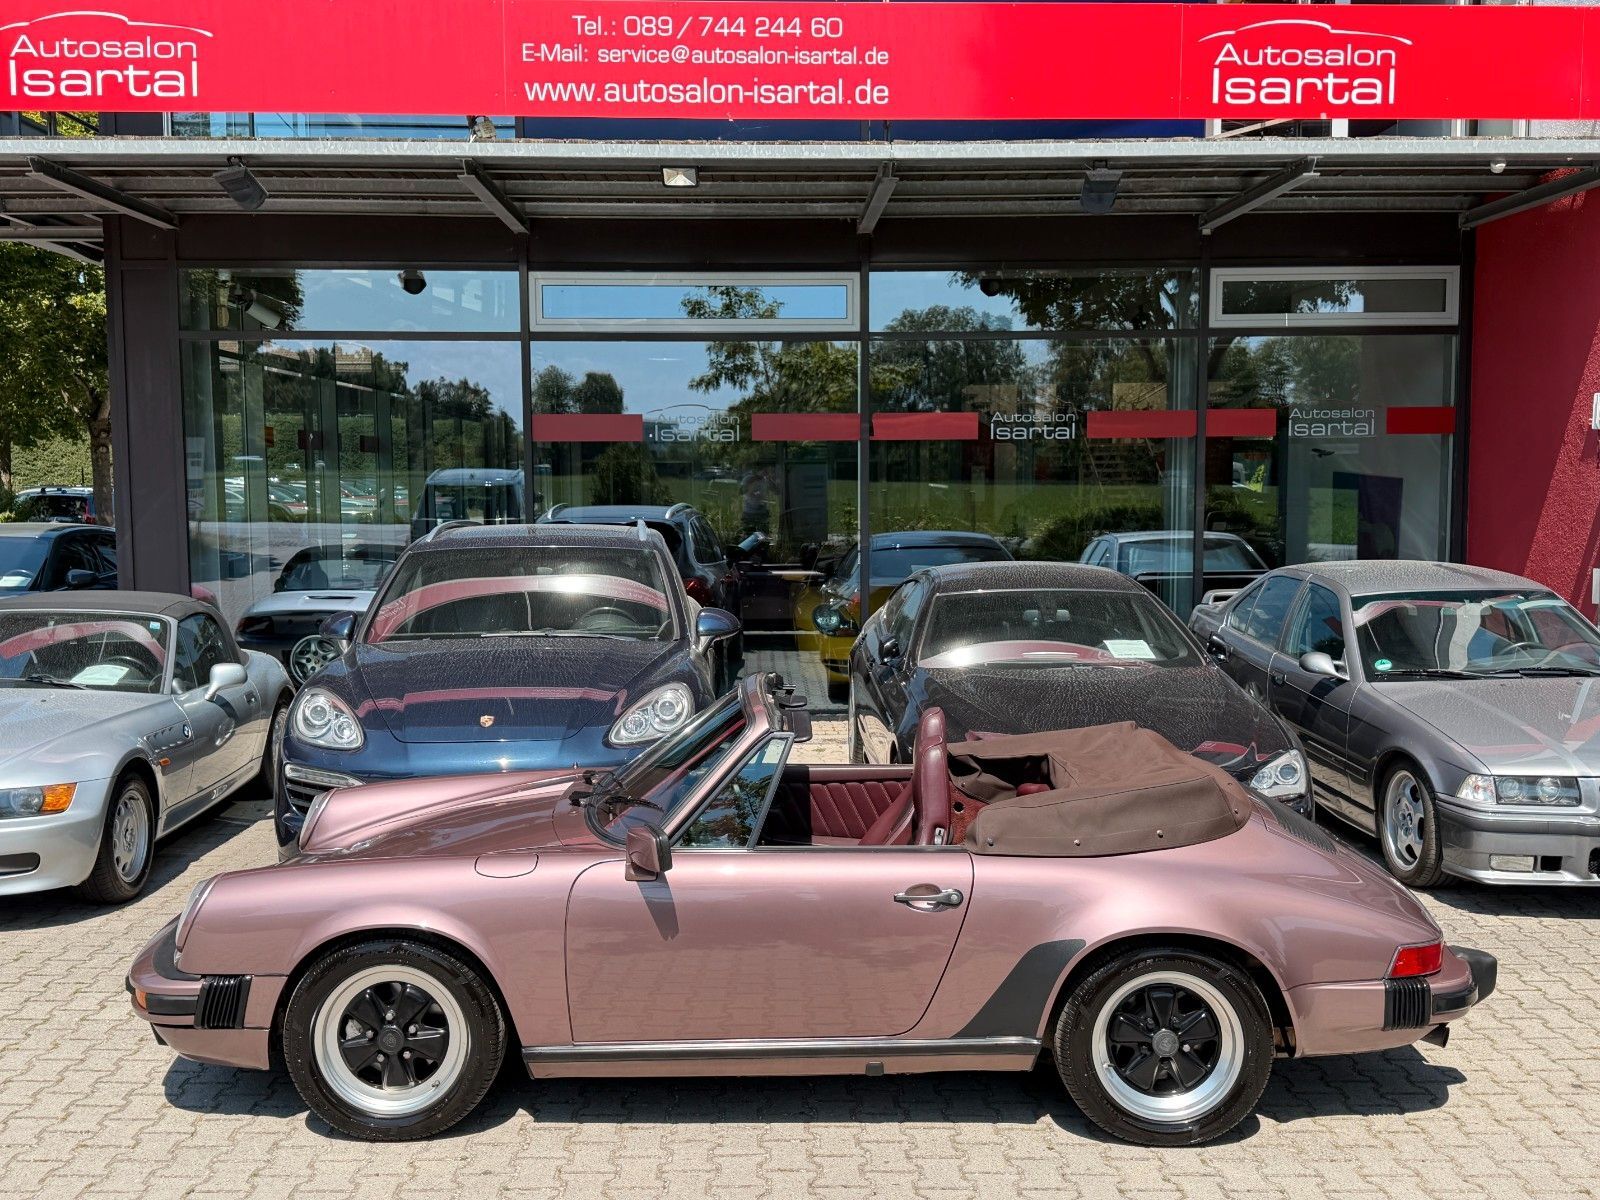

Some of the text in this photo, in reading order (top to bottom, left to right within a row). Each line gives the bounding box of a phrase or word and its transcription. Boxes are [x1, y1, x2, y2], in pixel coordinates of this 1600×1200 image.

[572, 15, 616, 36] Tel.:
[755, 17, 802, 37] 244
[811, 17, 843, 38] 60
[9, 34, 197, 58] Autosalon
[522, 43, 889, 65] E-Mail: service@autosalon-isartal.de
[1214, 42, 1397, 67] Autosalon
[8, 59, 198, 97] Isartal
[1212, 67, 1396, 105] Isartal
[523, 77, 890, 105] www.autosalon-isartal.de
[990, 411, 1076, 423] Autosalon
[1288, 407, 1375, 419] Autosalon
[654, 424, 740, 442] Isartal
[990, 422, 1076, 440] Isartal
[1288, 418, 1375, 437] Isartal
